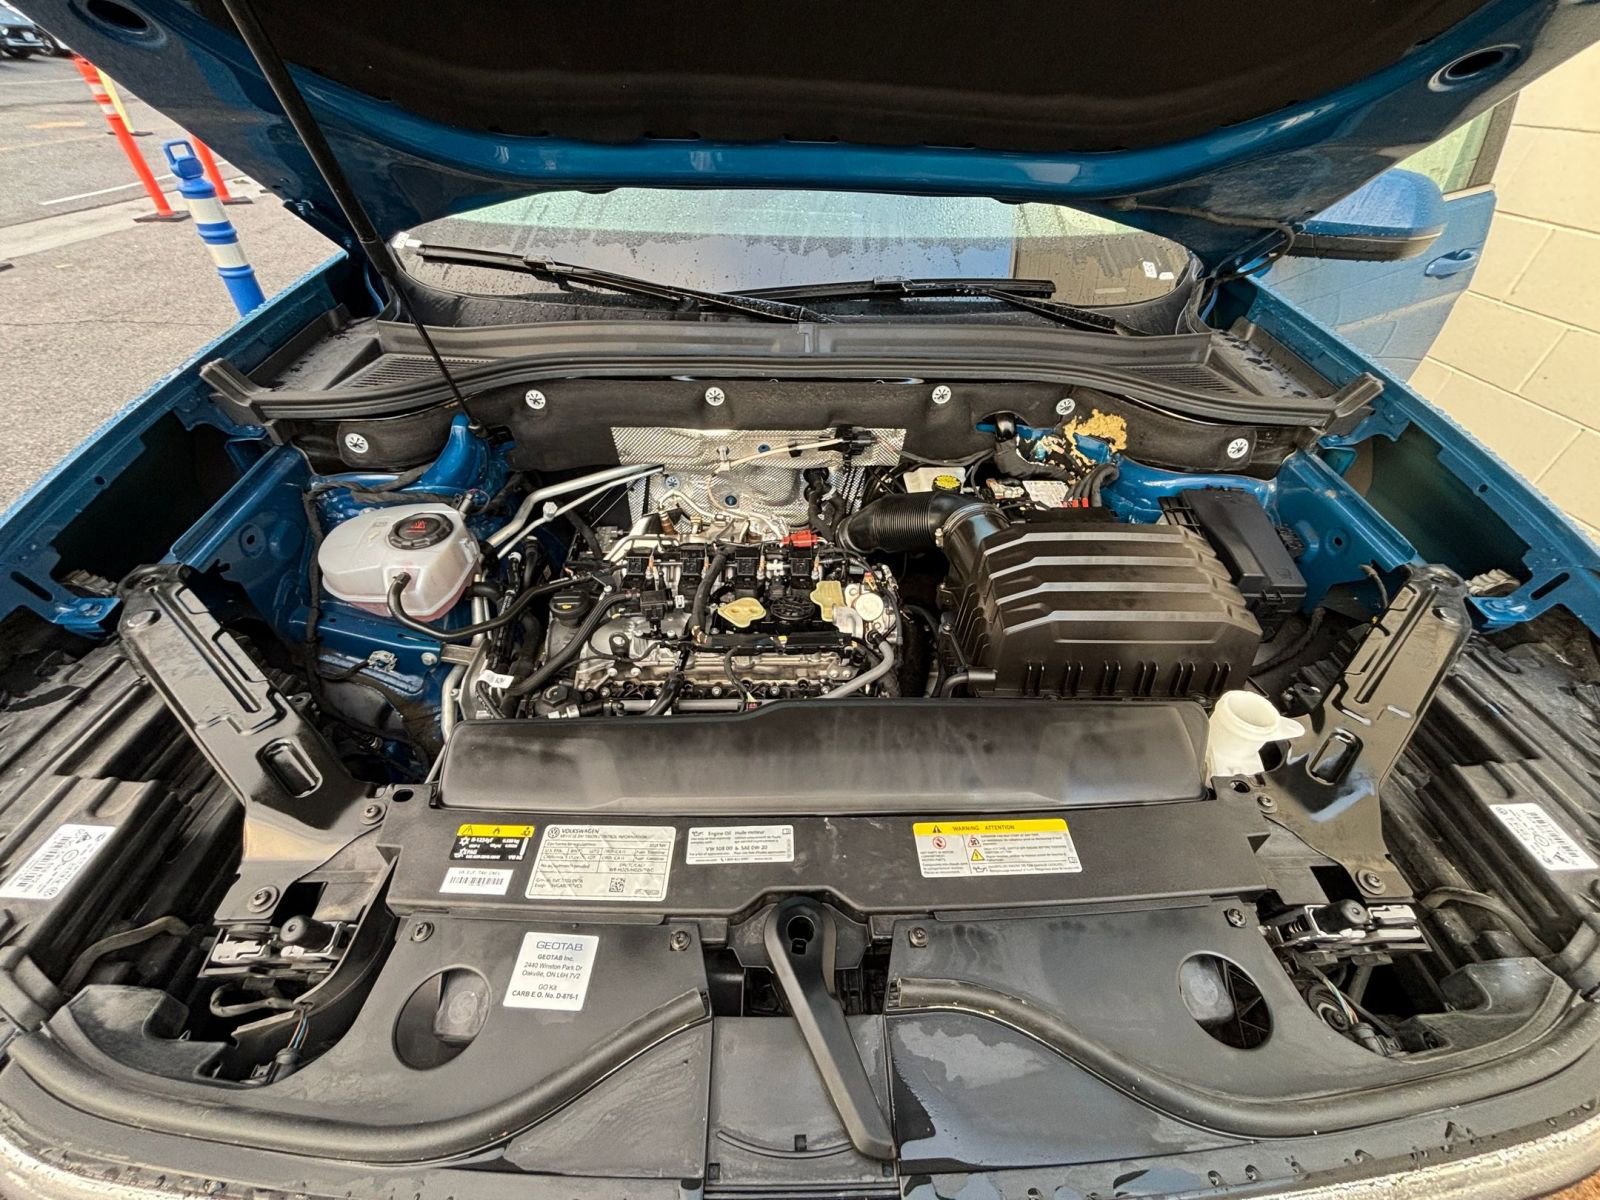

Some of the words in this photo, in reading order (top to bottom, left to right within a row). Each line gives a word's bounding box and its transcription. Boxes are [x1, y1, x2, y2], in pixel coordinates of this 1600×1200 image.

[536, 941, 583, 951] GEOTAB
[522, 970, 545, 978] Oakville,
[545, 991, 555, 999] No.
